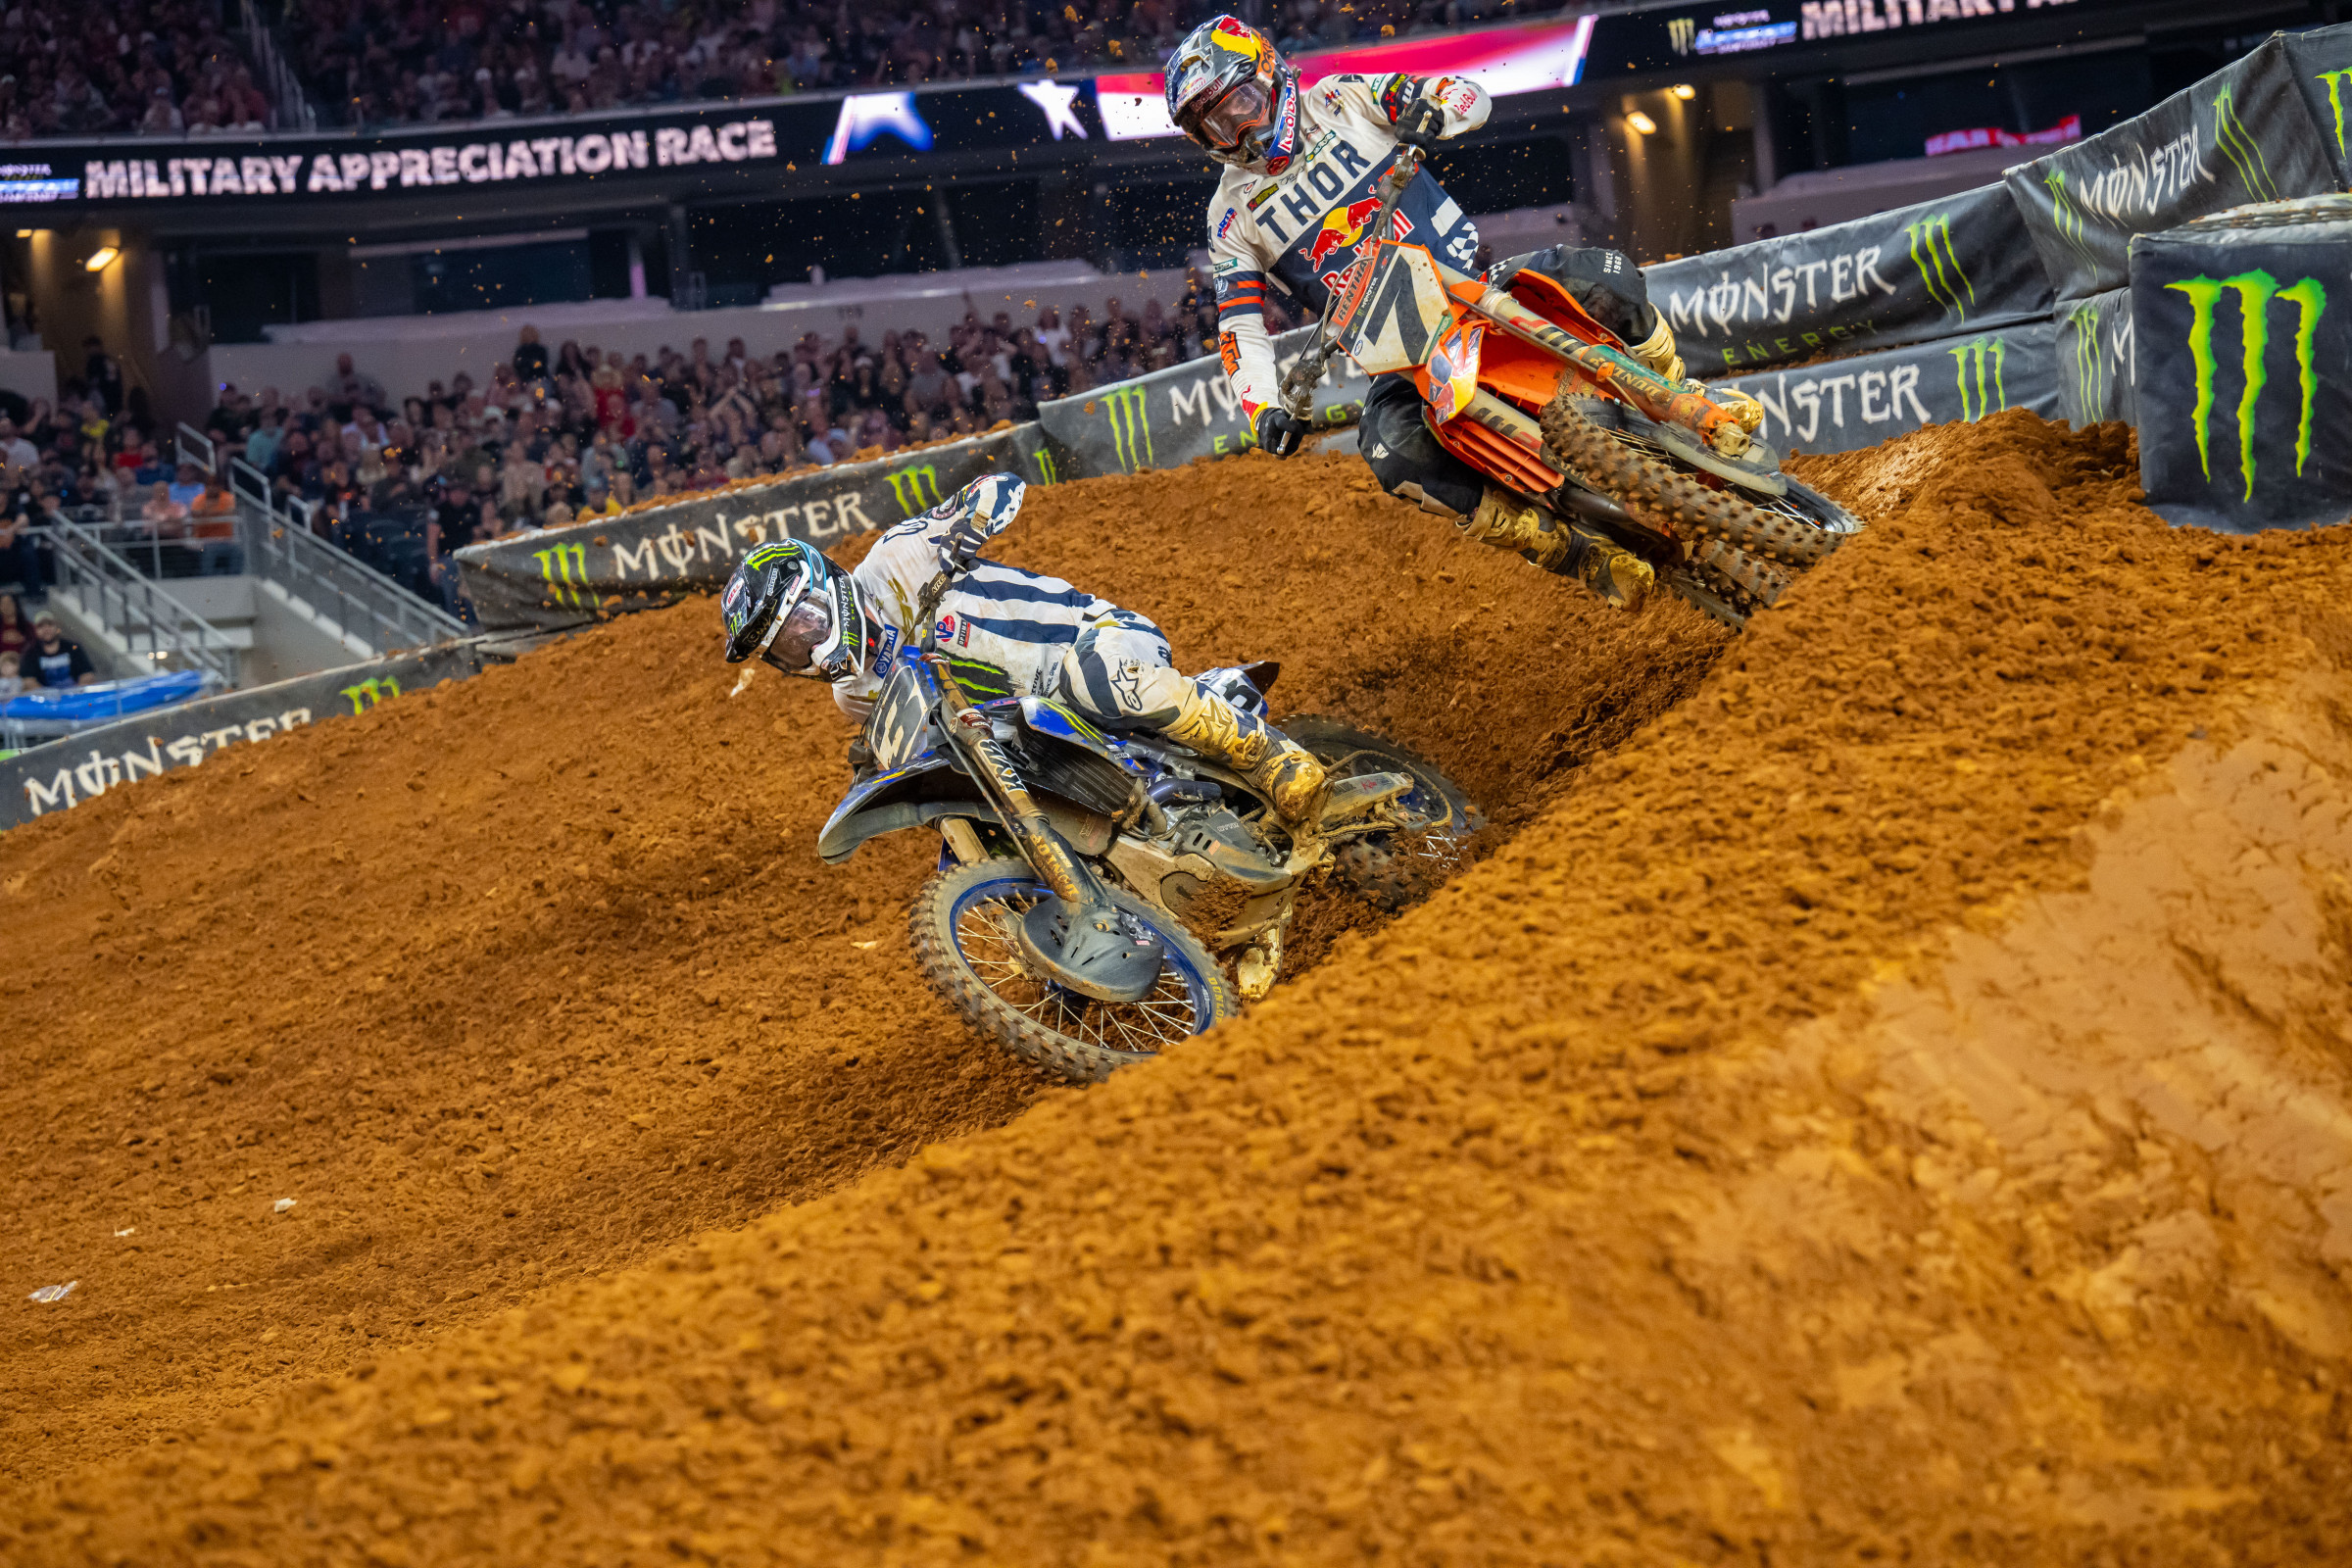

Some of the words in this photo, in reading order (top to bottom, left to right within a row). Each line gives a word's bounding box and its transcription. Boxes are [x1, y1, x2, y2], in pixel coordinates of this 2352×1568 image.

[85, 155, 303, 199] MILITARY
[307, 129, 650, 193] APPRECIATION
[655, 120, 778, 167] RACE
[1255, 139, 1372, 245] THOR
[2079, 123, 2216, 230] MONSTER
[1602, 251, 1614, 274] SINCE
[1669, 244, 1897, 337] MONSTER
[1363, 252, 1430, 367] 7
[1722, 319, 1879, 367] ENERGY
[1589, 357, 1661, 402] DUNLP
[1733, 364, 1932, 442] NSTER
[612, 492, 877, 580] MONSTER
[838, 576, 851, 628] MONSTER
[958, 620, 968, 646] OPTIMA
[1029, 833, 1081, 898] DUNLOP
